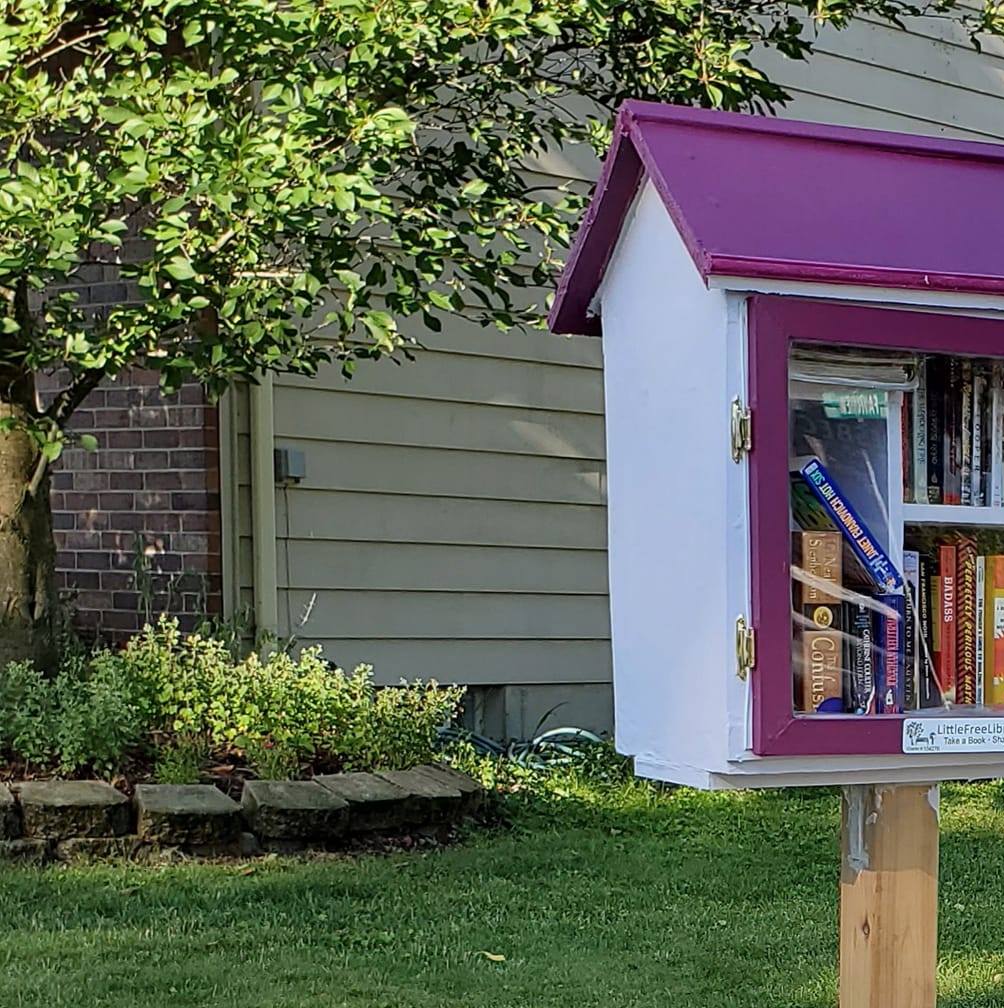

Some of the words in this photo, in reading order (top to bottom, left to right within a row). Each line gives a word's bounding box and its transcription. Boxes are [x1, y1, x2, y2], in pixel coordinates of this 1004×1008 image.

[810, 469, 827, 486] SIX
[819, 480, 836, 503] HOT
[830, 496, 864, 539] EVANOVICH
[857, 529, 880, 562] JANET
[944, 576, 954, 623] BADASS
[965, 560, 974, 617] PERFECTLY
[964, 621, 973, 671] PERILOUS
[863, 663, 872, 693] COULTER
[944, 737, 960, 745] Take
[968, 736, 986, 745] Book
